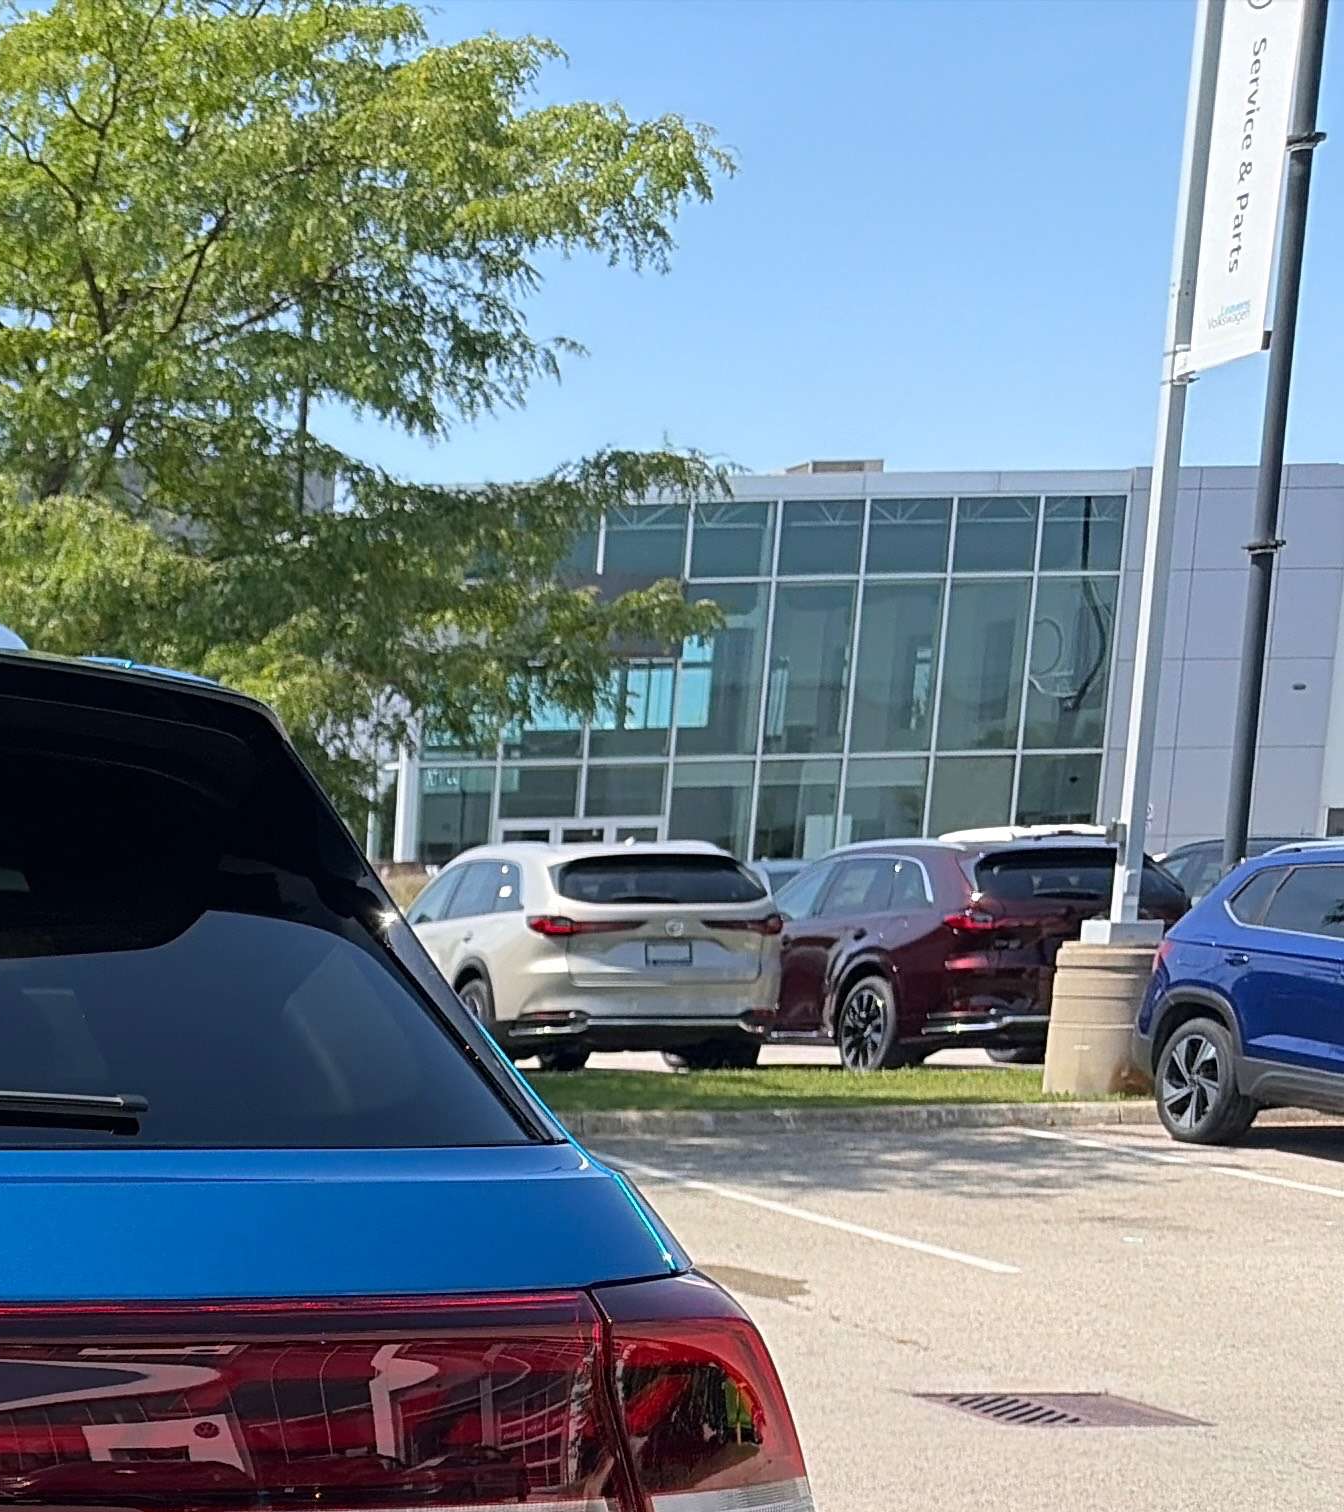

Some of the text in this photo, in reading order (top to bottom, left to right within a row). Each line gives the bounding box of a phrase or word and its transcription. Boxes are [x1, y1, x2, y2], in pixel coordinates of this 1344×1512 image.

[1228, 37, 1268, 274] Service & Parts
